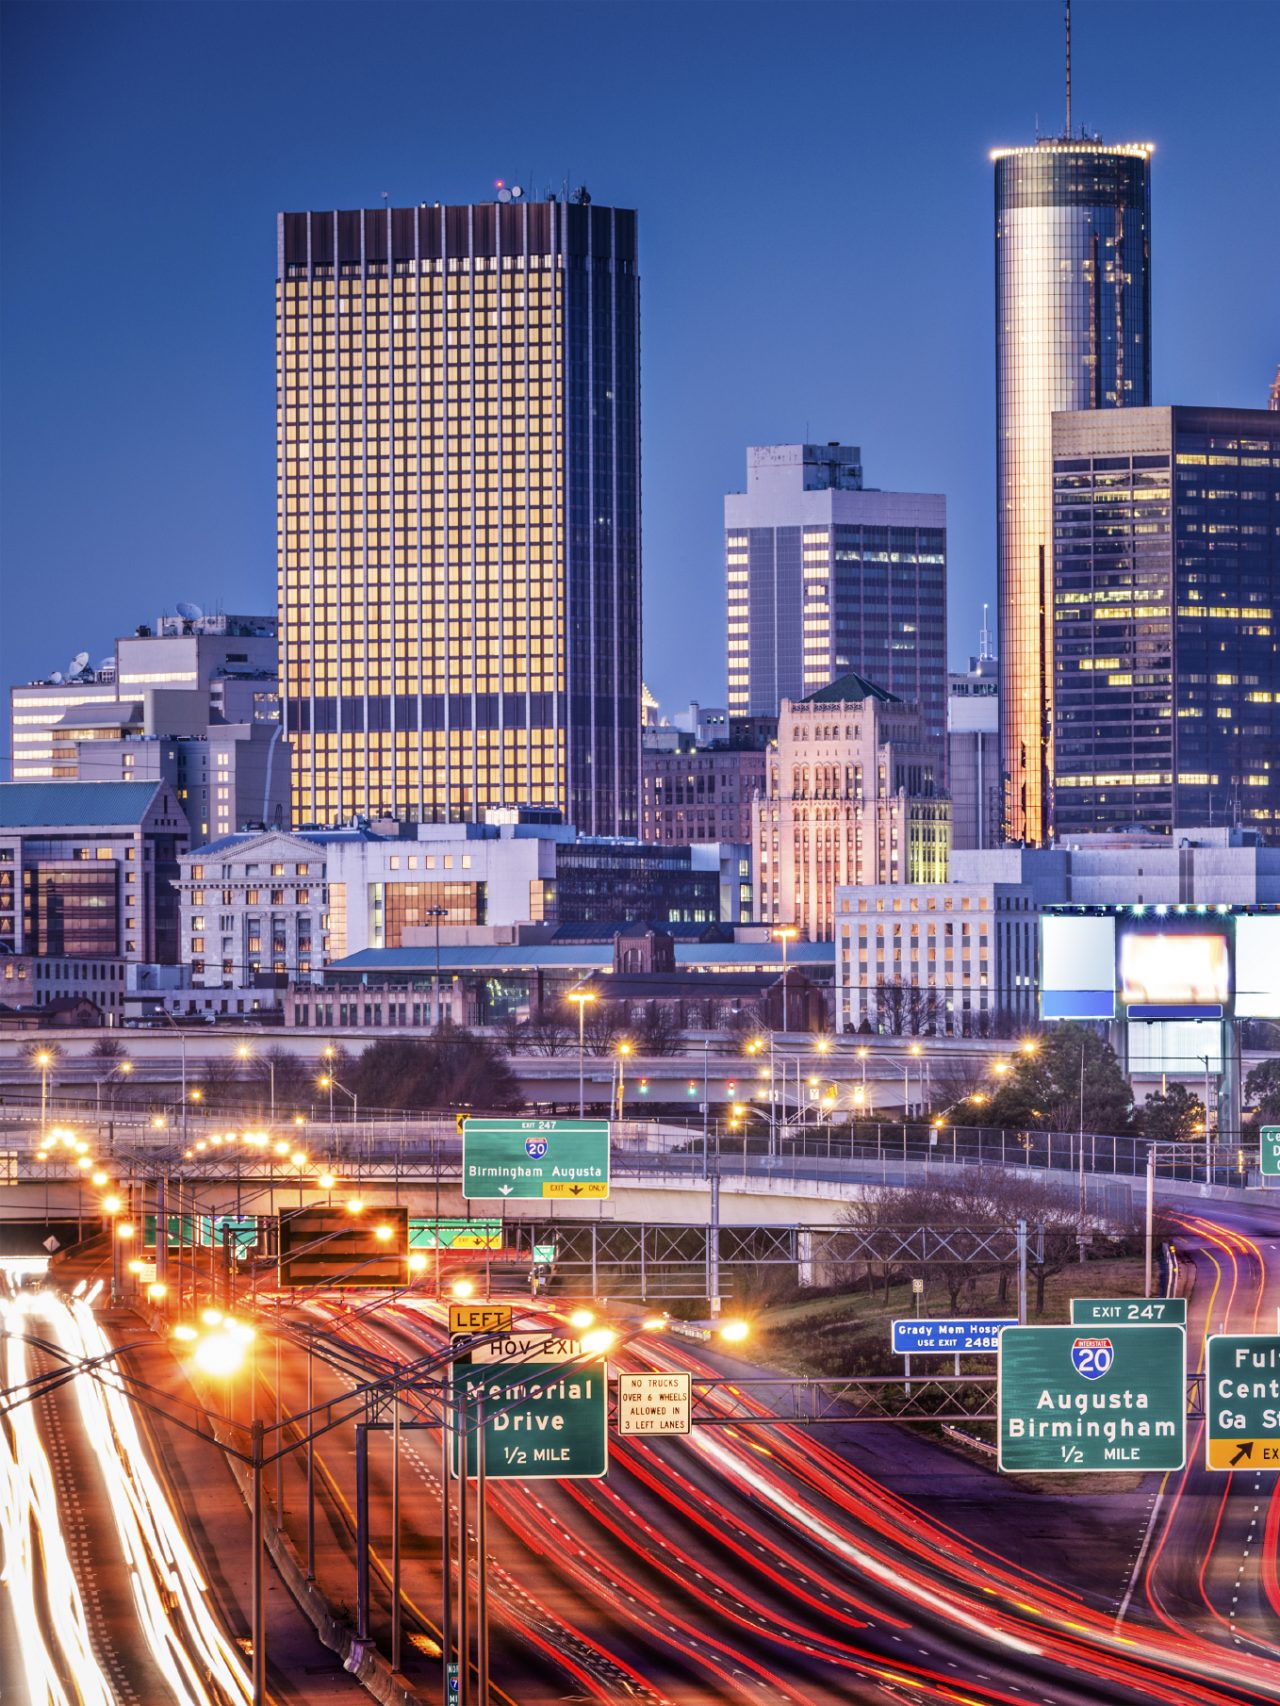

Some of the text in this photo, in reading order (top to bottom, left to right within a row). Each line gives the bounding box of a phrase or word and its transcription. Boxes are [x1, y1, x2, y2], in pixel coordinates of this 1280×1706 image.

[539, 1121, 556, 1130] 247
[528, 1144, 545, 1155] 20
[469, 1165, 601, 1180] Birmingham Augusta
[1093, 1305, 1165, 1320] EXIT 247
[457, 1313, 504, 1327] LEFT
[899, 1326, 932, 1336] Grady
[938, 1326, 964, 1334] Mem
[491, 1341, 531, 1355] HOV
[1078, 1348, 1110, 1372] 20
[466, 1380, 592, 1400] Memorial
[631, 1379, 679, 1387] NO TRUCKS
[623, 1393, 642, 1401] OVER
[659, 1393, 687, 1401] WHEELS
[1037, 1390, 1148, 1415] Augusta
[630, 1407, 680, 1415] ALLOWED IN
[493, 1411, 565, 1431] Drive
[625, 1421, 685, 1429] 3 LEFT LANES
[1218, 1409, 1246, 1429] Ga
[1009, 1418, 1176, 1443] Birmingham
[533, 1448, 570, 1461] MILE
[1104, 1448, 1140, 1460] MILE
